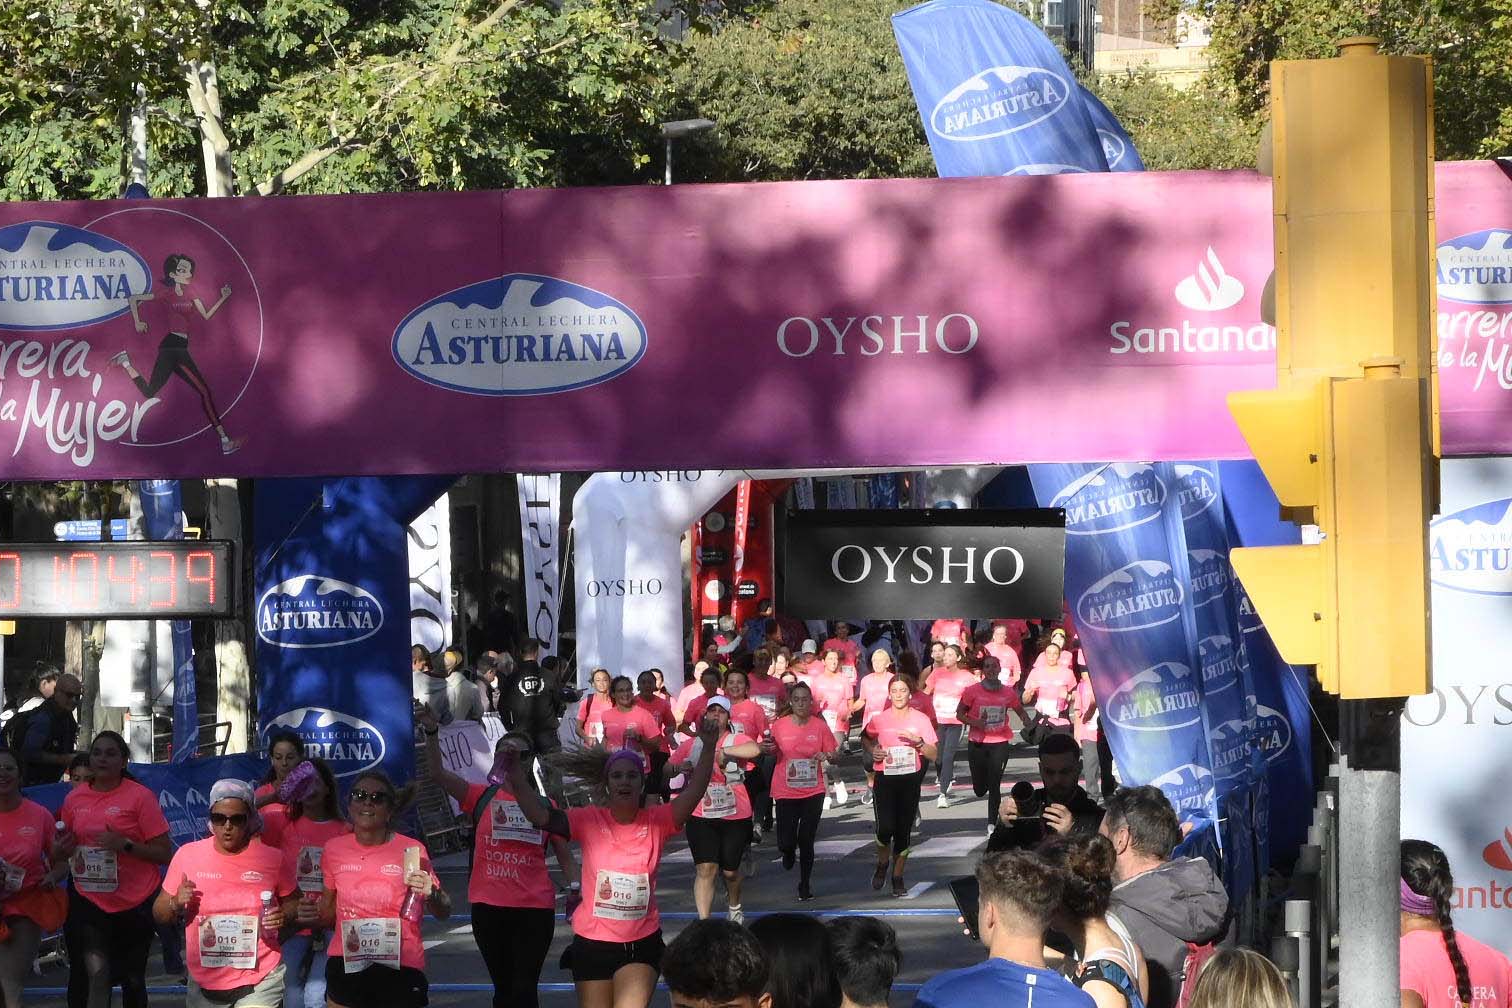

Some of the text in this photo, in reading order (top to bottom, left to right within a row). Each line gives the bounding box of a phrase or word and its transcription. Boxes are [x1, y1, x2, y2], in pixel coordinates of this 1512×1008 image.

[54, 257, 126, 269] LECHERA
[451, 314, 618, 329] CENTRAL LECHERA
[776, 312, 979, 358] OYSHO
[412, 321, 627, 368] ASTURIANA
[13, 374, 162, 467] Mujer
[831, 545, 1025, 585] OYSHO
[586, 579, 662, 597] OYSHO
[261, 605, 374, 632] ASTURIANA
[524, 681, 538, 690] BP
[486, 849, 532, 865] DORSAL
[487, 863, 519, 878] SUMA
[217, 935, 237, 944] 016
[360, 938, 380, 947] 016
